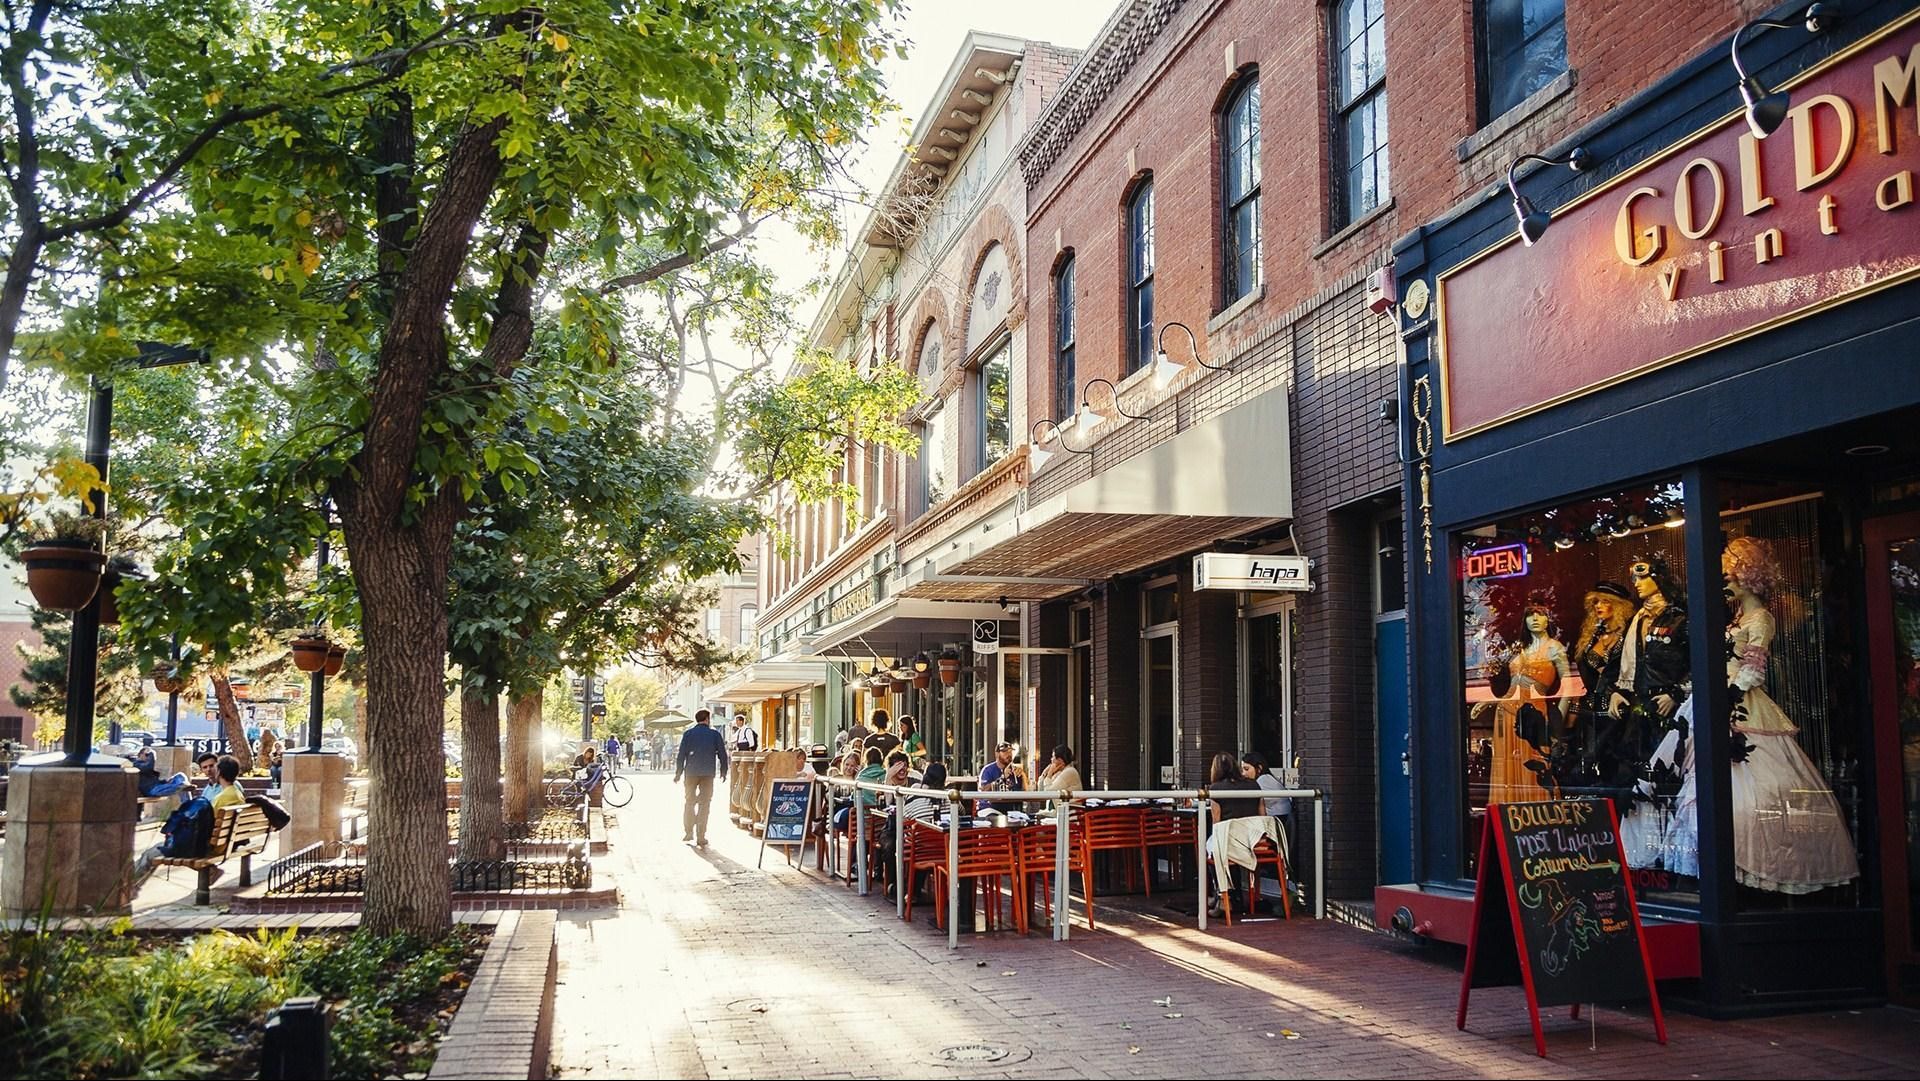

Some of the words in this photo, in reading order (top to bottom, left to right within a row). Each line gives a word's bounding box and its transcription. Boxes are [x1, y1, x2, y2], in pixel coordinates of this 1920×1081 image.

[1250, 562, 1299, 584] hapa
[1468, 551, 1523, 577] OPEN
[780, 783, 806, 792] hapa
[1552, 827, 1614, 862] Unique
[1522, 853, 1589, 880] Costumes
